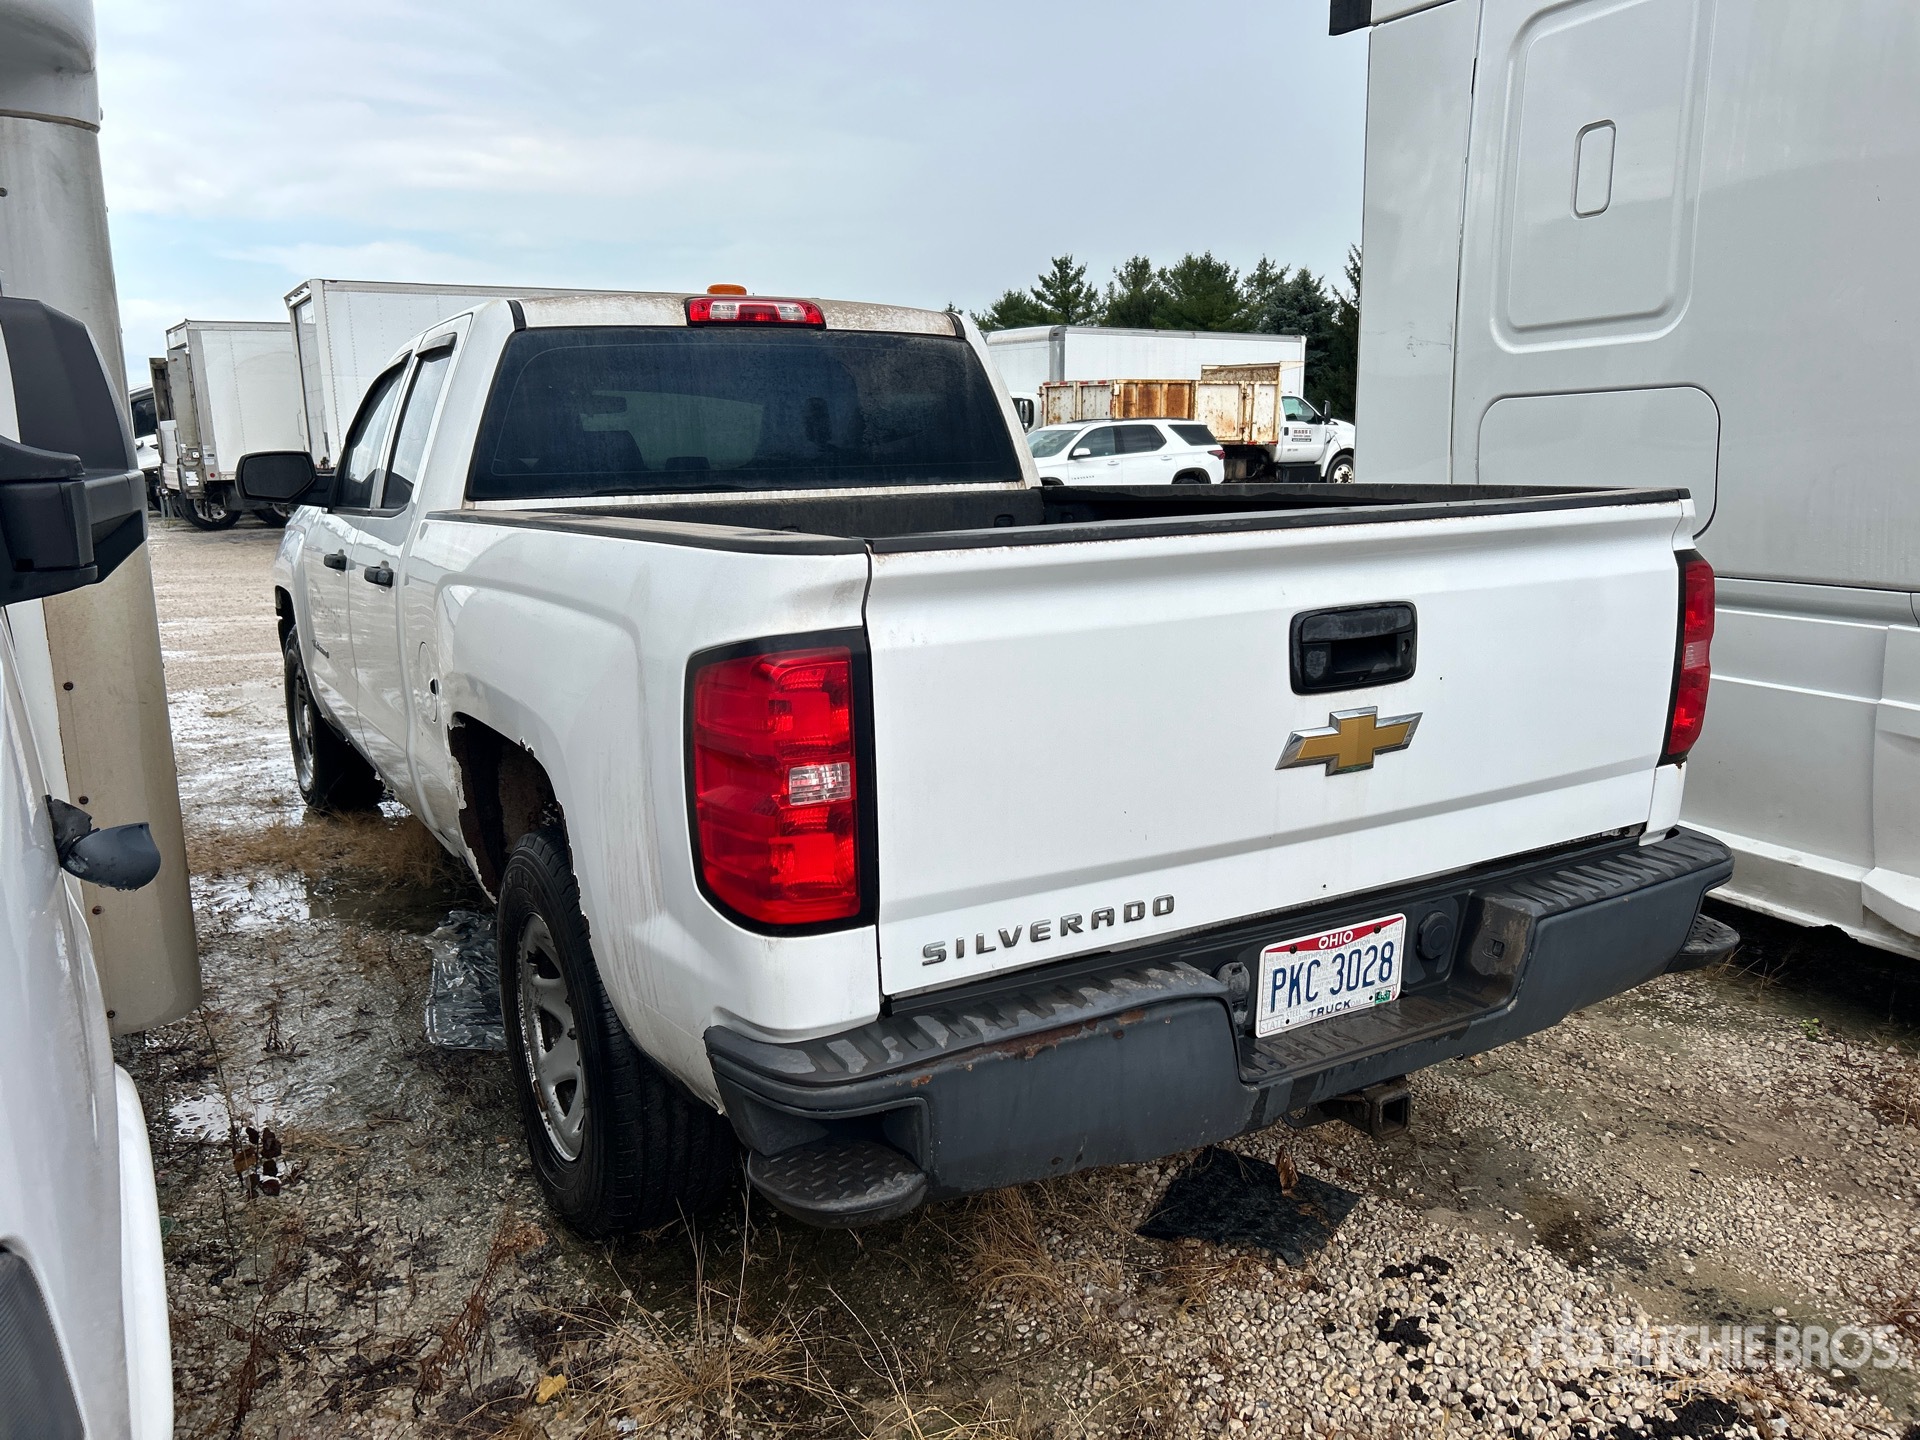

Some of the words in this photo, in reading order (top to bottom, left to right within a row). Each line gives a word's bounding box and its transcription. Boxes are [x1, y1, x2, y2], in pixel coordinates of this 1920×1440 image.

[922, 894, 1174, 966] SILVERADO
[1319, 931, 1353, 949] OHIO
[1298, 949, 1333, 961] BIRTHPLACE
[1344, 939, 1370, 950] AVIATION
[1271, 959, 1320, 1013] PKC
[1330, 941, 1394, 995] 3028
[1309, 1000, 1350, 1019] TRUCK
